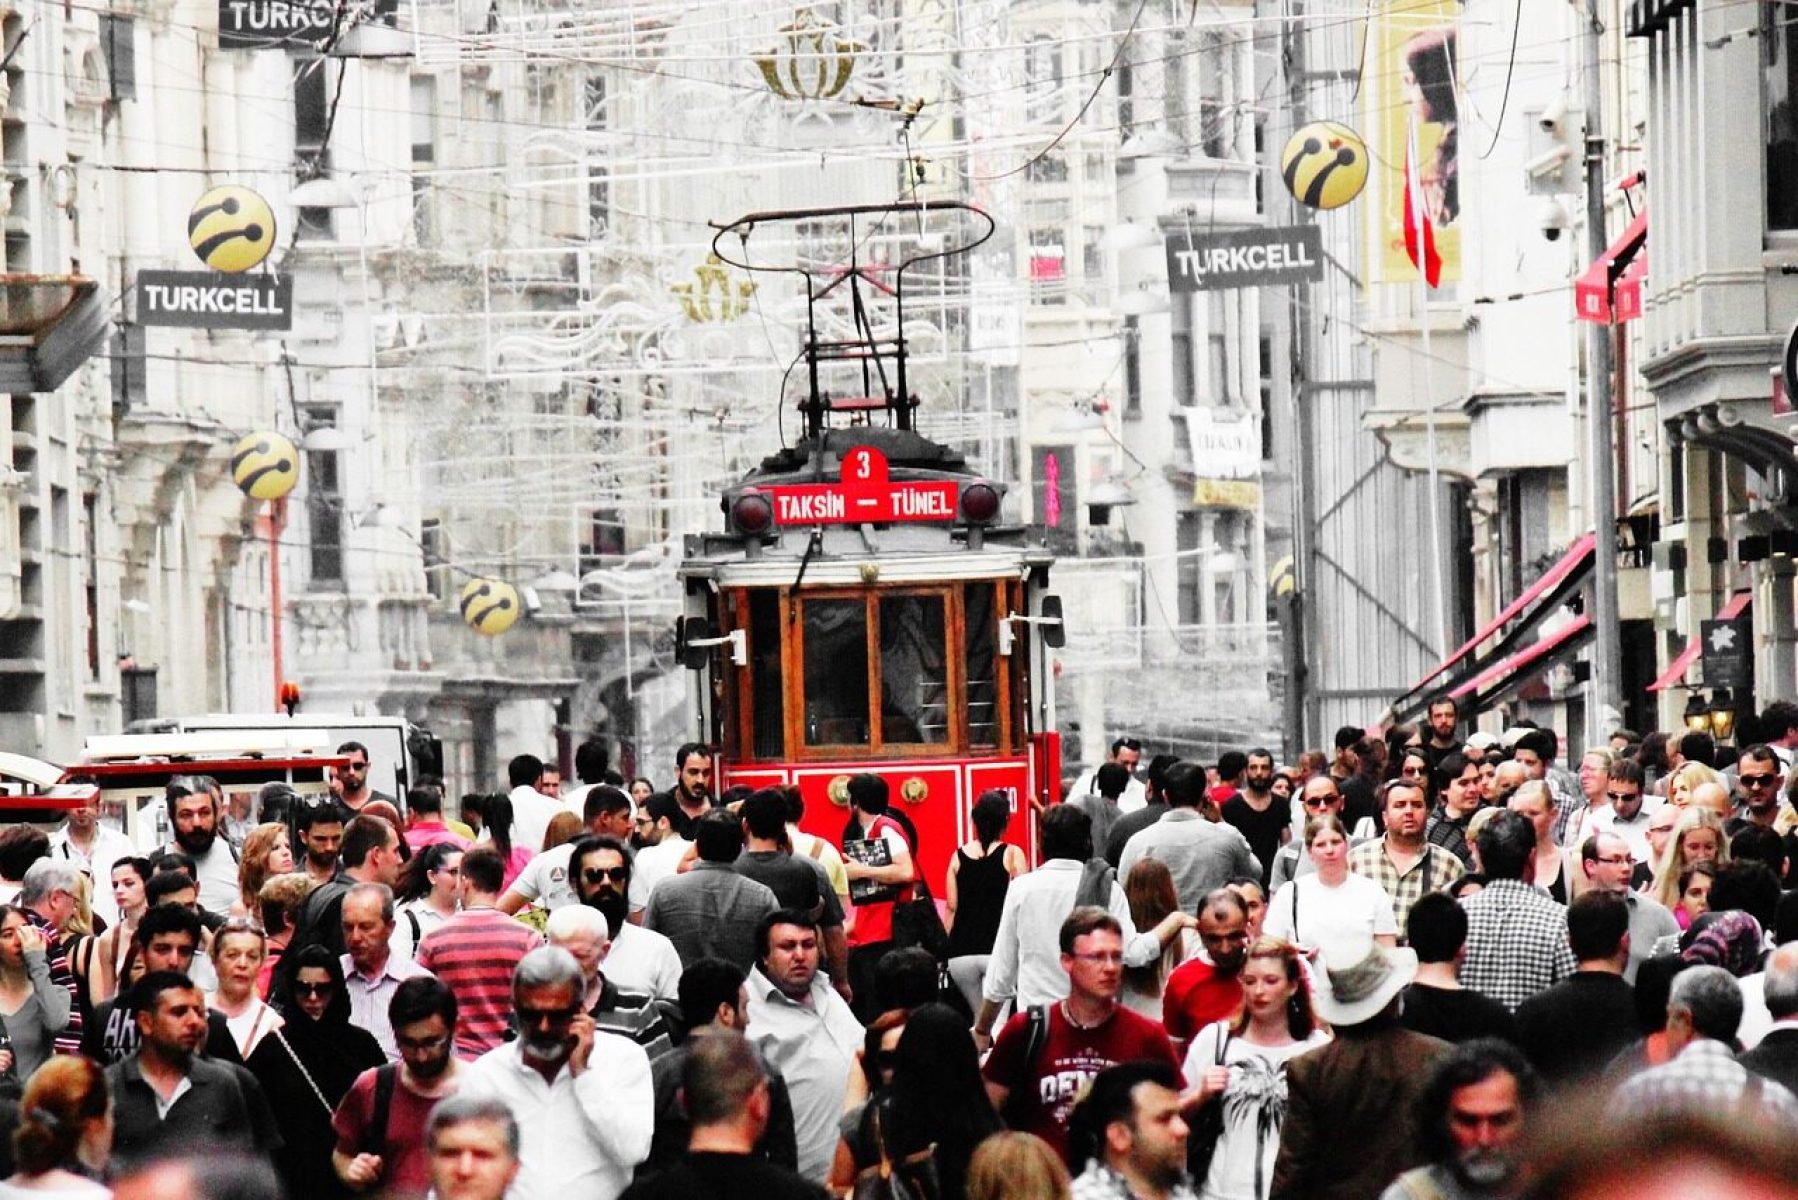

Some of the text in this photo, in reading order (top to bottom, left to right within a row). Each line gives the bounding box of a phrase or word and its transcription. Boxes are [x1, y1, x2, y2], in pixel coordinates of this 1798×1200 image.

[229, 0, 375, 30] TURKC
[1175, 242, 1315, 276] TURKCELL
[145, 285, 284, 314] TURKCELL
[857, 451, 870, 479] 3
[891, 488, 953, 516] TÜNEL
